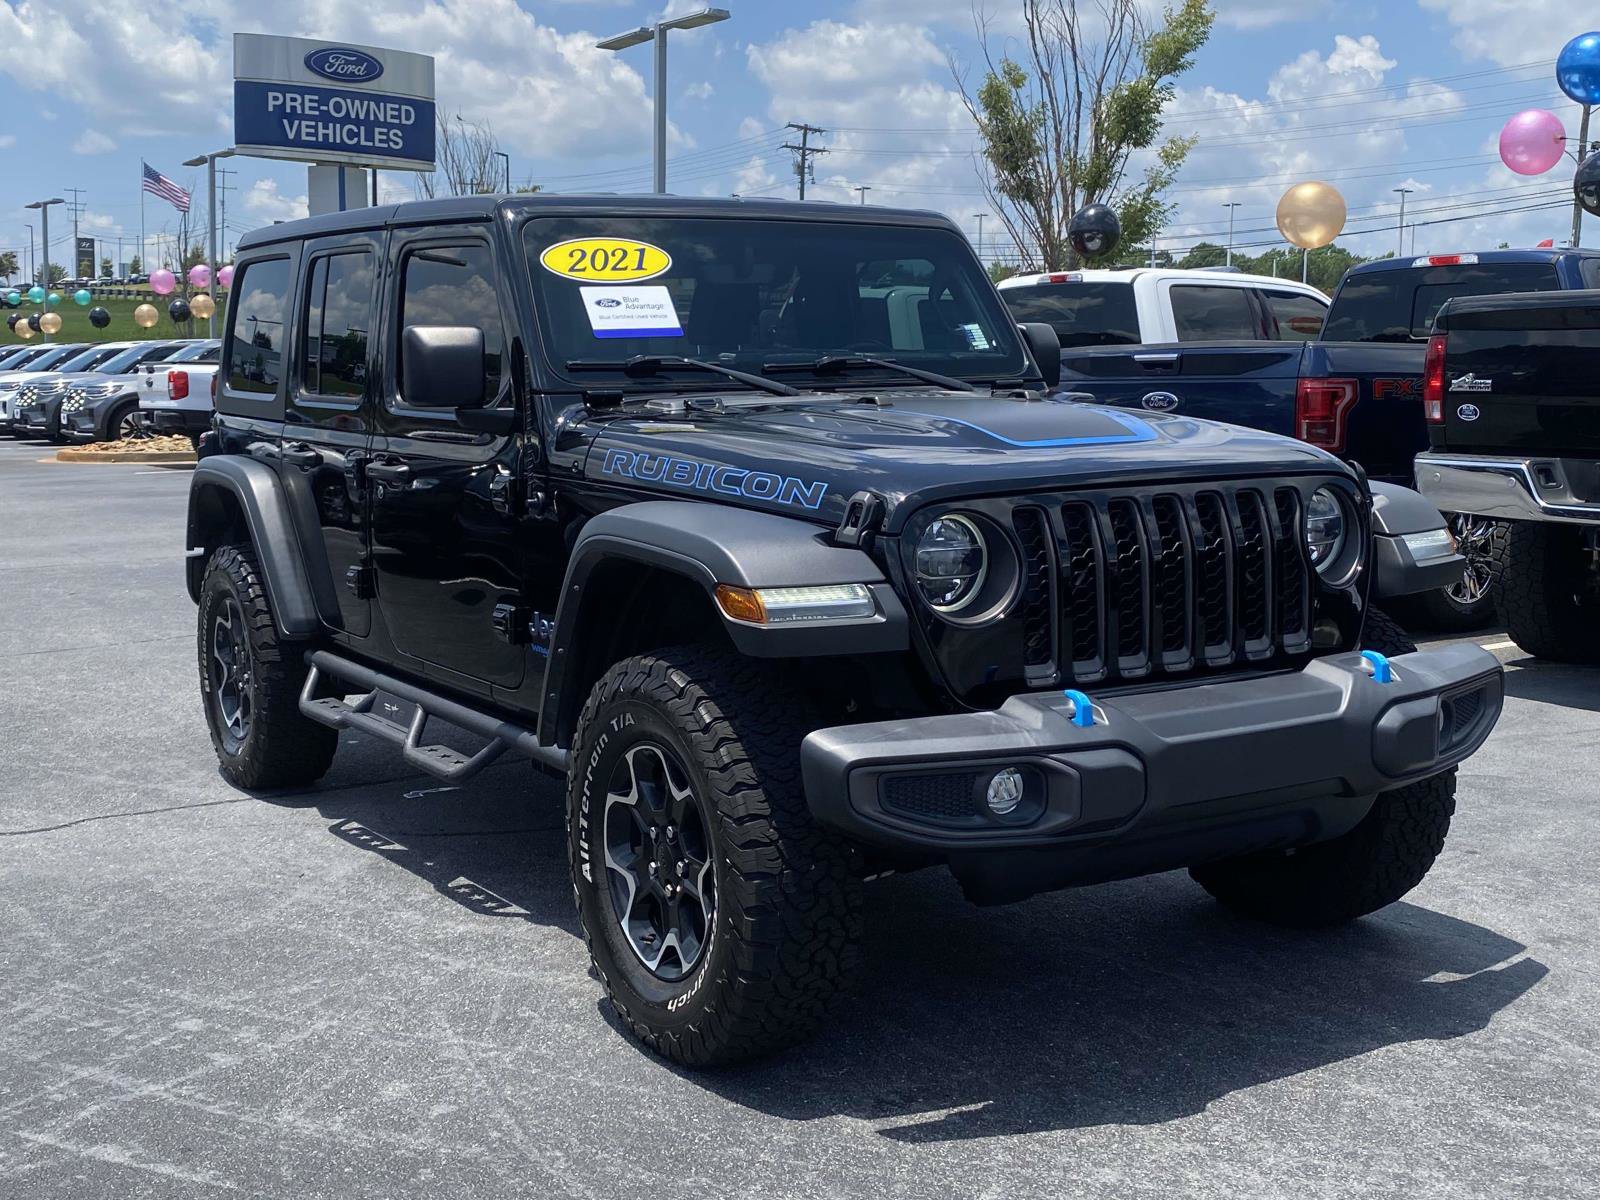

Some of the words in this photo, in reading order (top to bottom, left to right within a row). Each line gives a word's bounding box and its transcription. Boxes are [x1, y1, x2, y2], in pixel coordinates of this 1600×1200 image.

[325, 54, 367, 76] Ford
[267, 91, 416, 125] PRE-OWNED
[282, 119, 404, 149] VEHICLES
[568, 247, 648, 273] 2021
[602, 448, 828, 510] RUBICON
[579, 733, 608, 883] All-Terrain
[610, 712, 635, 732] T/A
